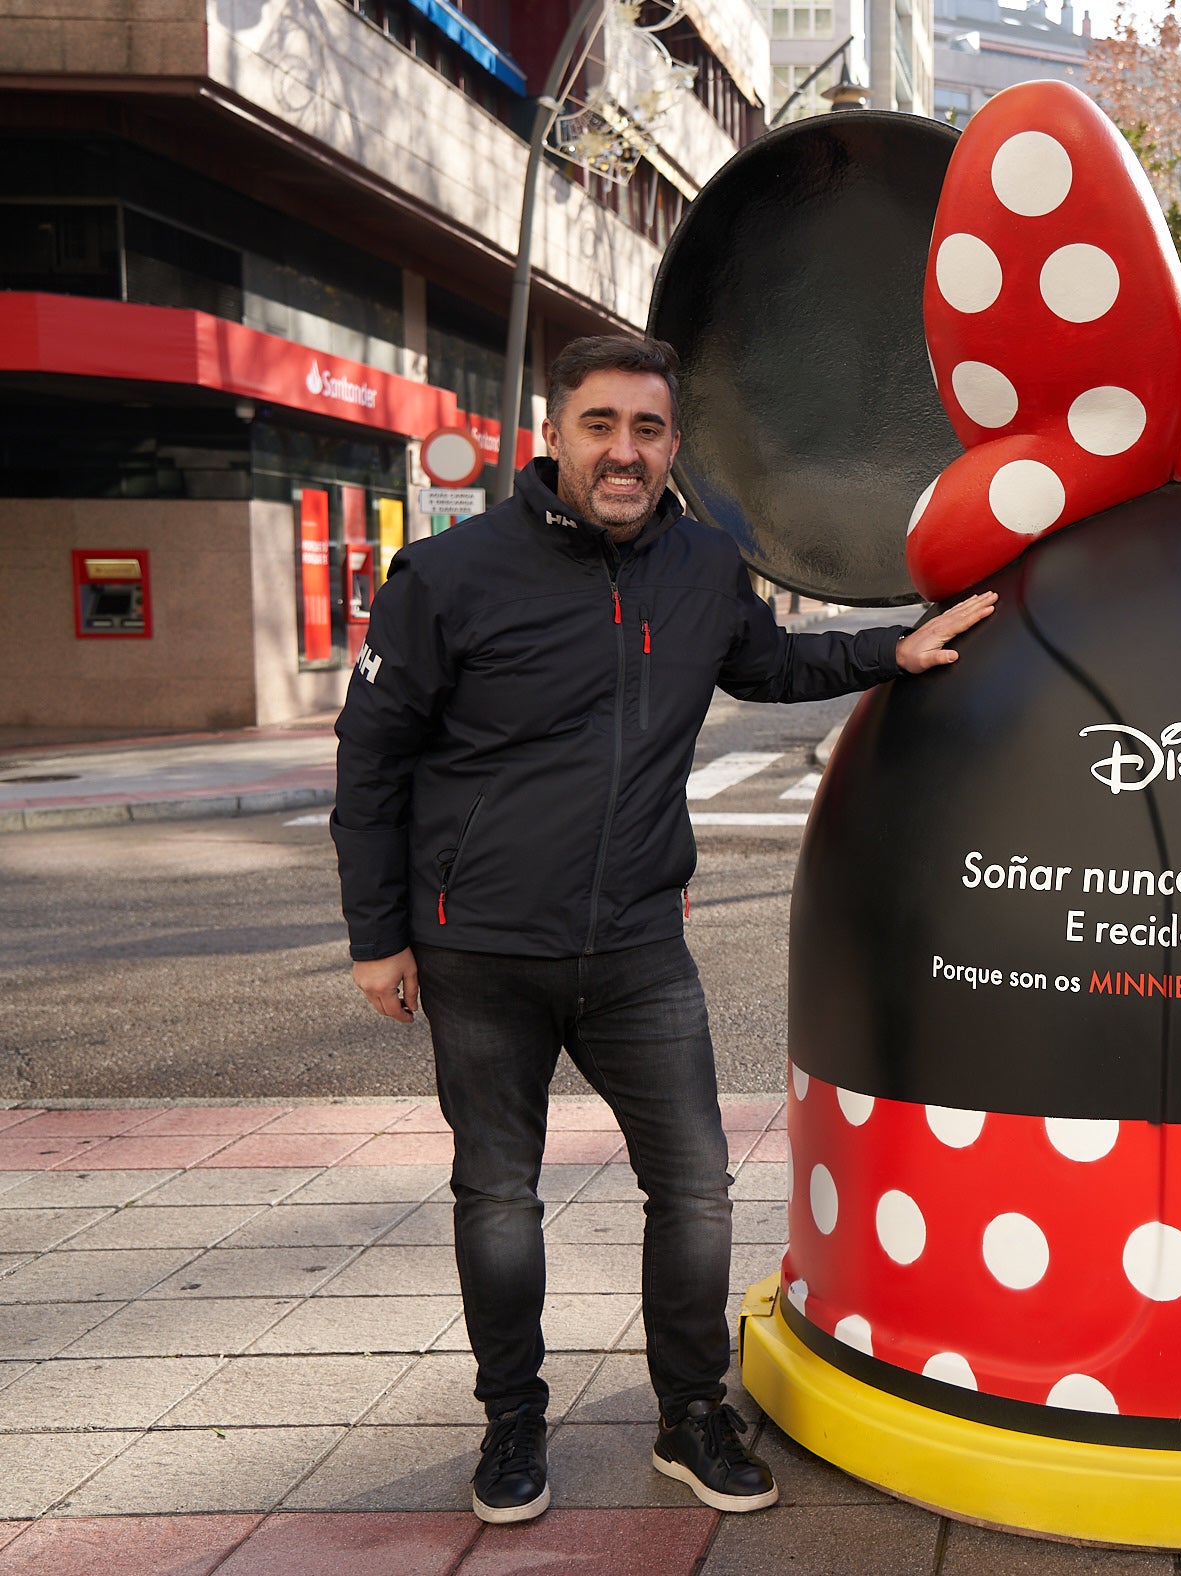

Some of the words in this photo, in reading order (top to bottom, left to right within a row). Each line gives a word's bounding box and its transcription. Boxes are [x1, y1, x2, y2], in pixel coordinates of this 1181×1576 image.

[322, 370, 377, 408] Santander
[545, 510, 578, 528] HH
[961, 851, 1073, 891] Soñar
[1066, 910, 1085, 942] E
[932, 955, 1003, 990] Porque
[1009, 971, 1047, 990] son
[1054, 975, 1081, 993] os
